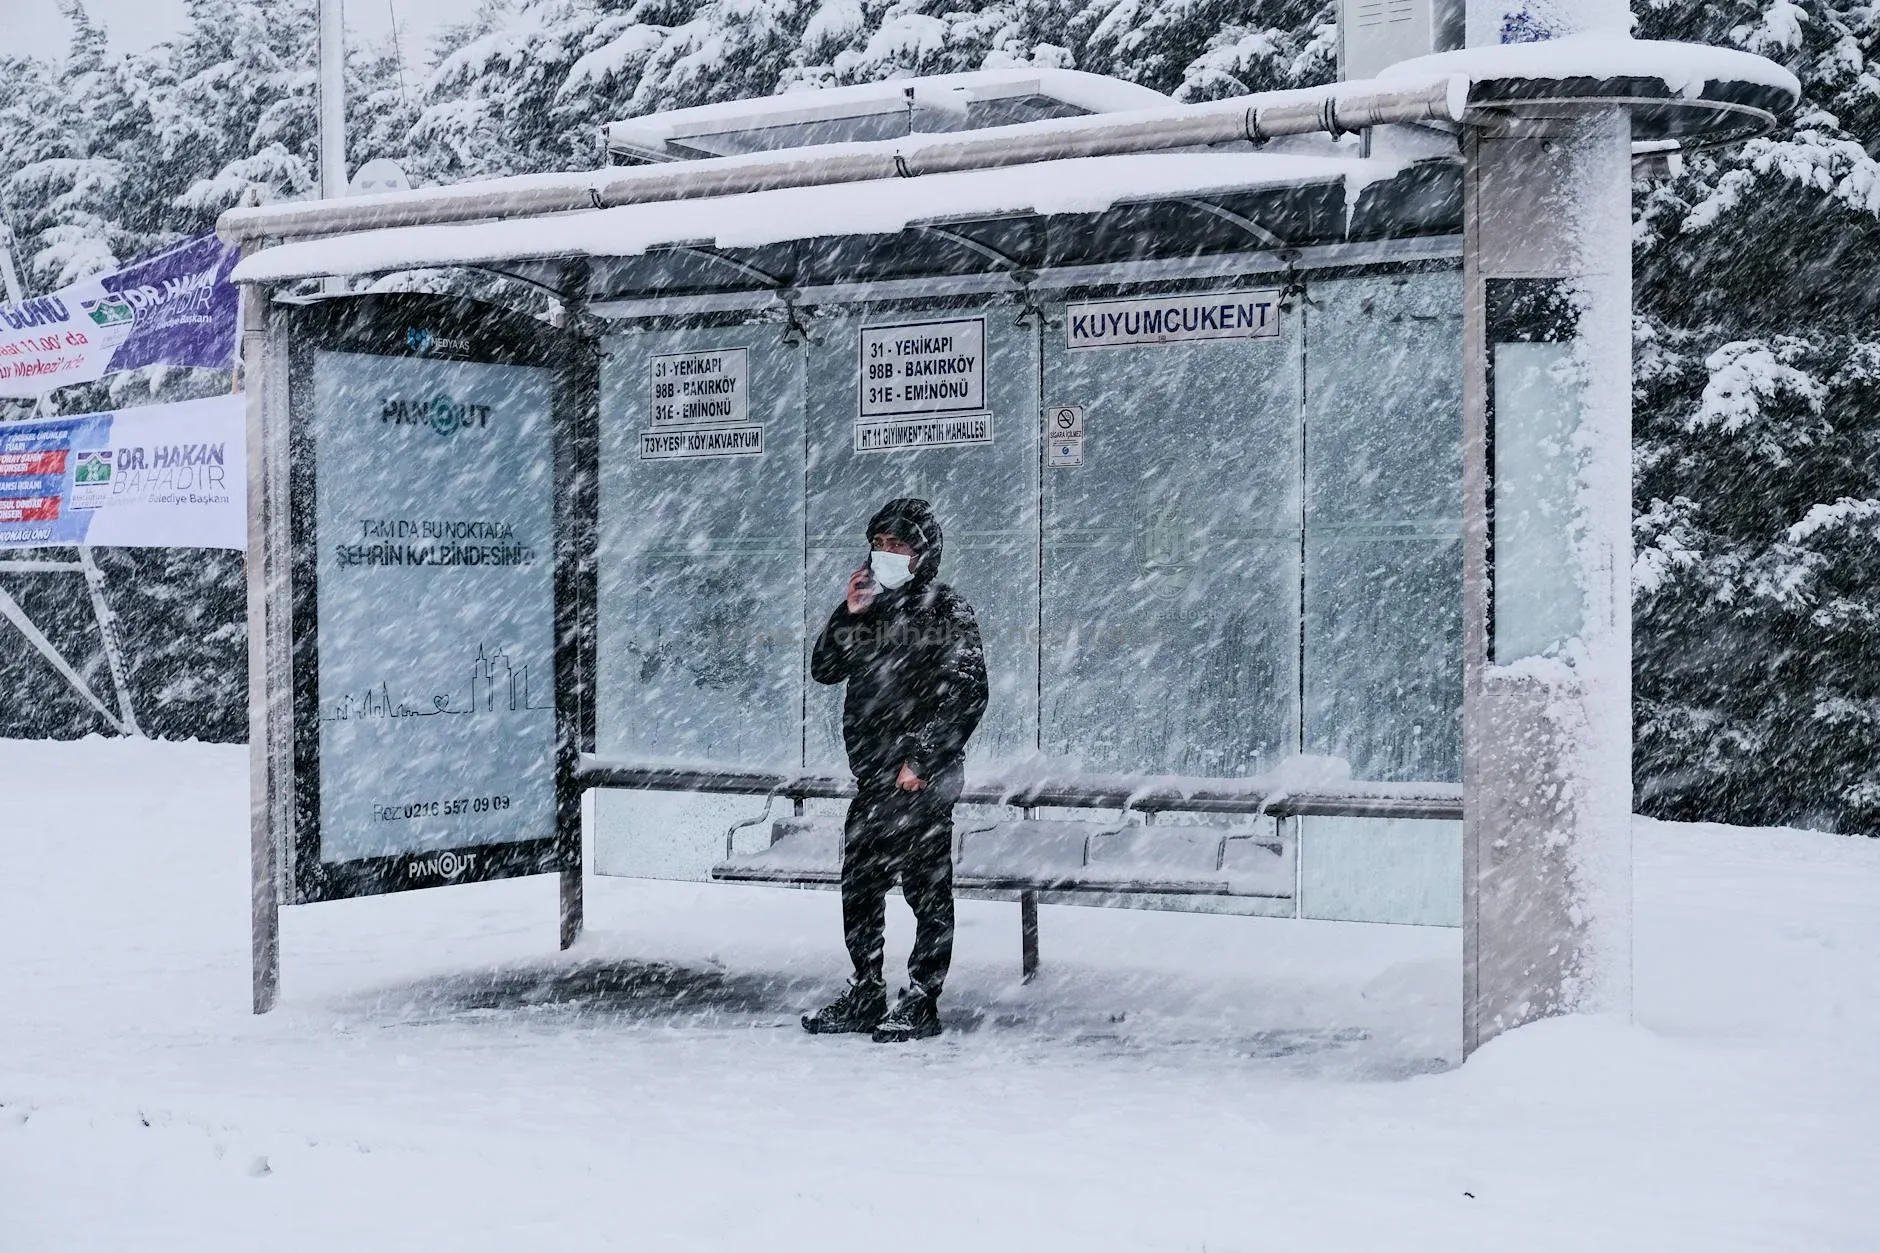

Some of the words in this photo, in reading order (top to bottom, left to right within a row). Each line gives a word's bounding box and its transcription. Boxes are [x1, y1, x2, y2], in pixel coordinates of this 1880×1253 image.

[1073, 303, 1271, 339] KUYUMCUKENT
[870, 342, 884, 359] 31
[895, 335, 952, 356] YENİKAPI
[655, 362, 667, 378] 31
[869, 363, 893, 380] 98B
[905, 355, 975, 377] BAKIRKÖY
[655, 383, 675, 399] 98B
[683, 375, 737, 397] BAKIRKÖY
[868, 386, 893, 404] 31E
[905, 378, 968, 400] EMİNÖNÜ
[655, 403, 674, 421] 31E
[682, 397, 731, 419] EMİNÖNÜ
[862, 428, 873, 448] HT
[873, 428, 882, 446] 11
[116, 448, 150, 471] DR.
[153, 442, 226, 469] HAKAN
[112, 464, 226, 495] BAHADIR
[422, 521, 443, 539] BU
[403, 800, 440, 819] 0216
[443, 797, 469, 816] 557
[472, 797, 490, 813] 09
[492, 794, 511, 811] 09
